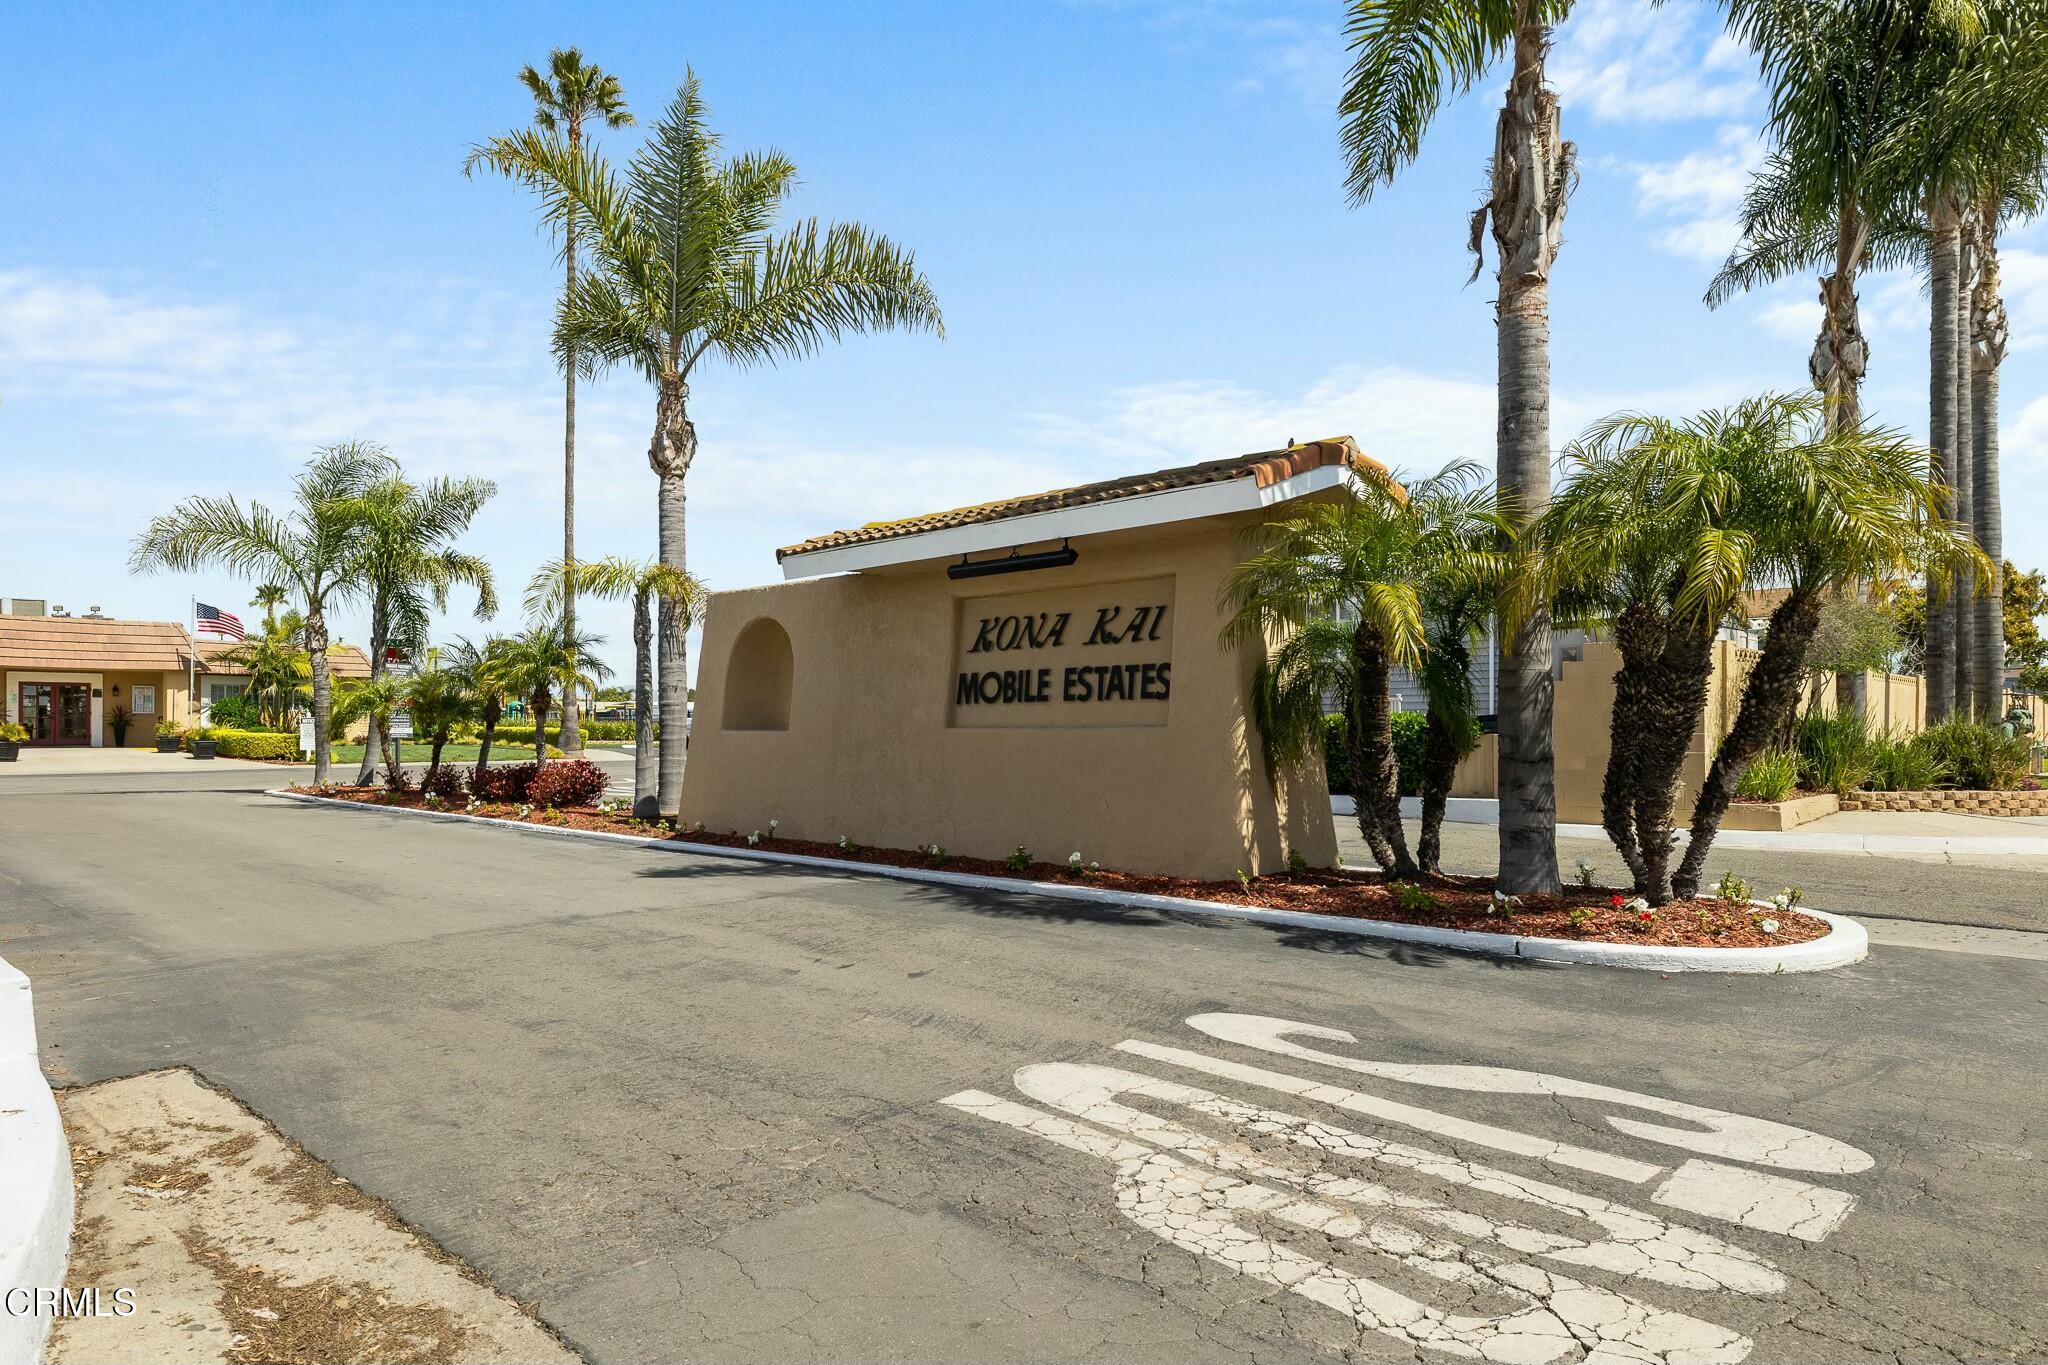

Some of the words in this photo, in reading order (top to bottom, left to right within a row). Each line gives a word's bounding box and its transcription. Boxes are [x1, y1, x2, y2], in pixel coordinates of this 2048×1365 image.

[967, 612, 1071, 653] KONA
[1083, 605, 1168, 646] KAI
[956, 668, 1052, 705] MOBILE
[1063, 662, 1171, 701] ESTATES
[938, 1012, 1876, 1365] STOP
